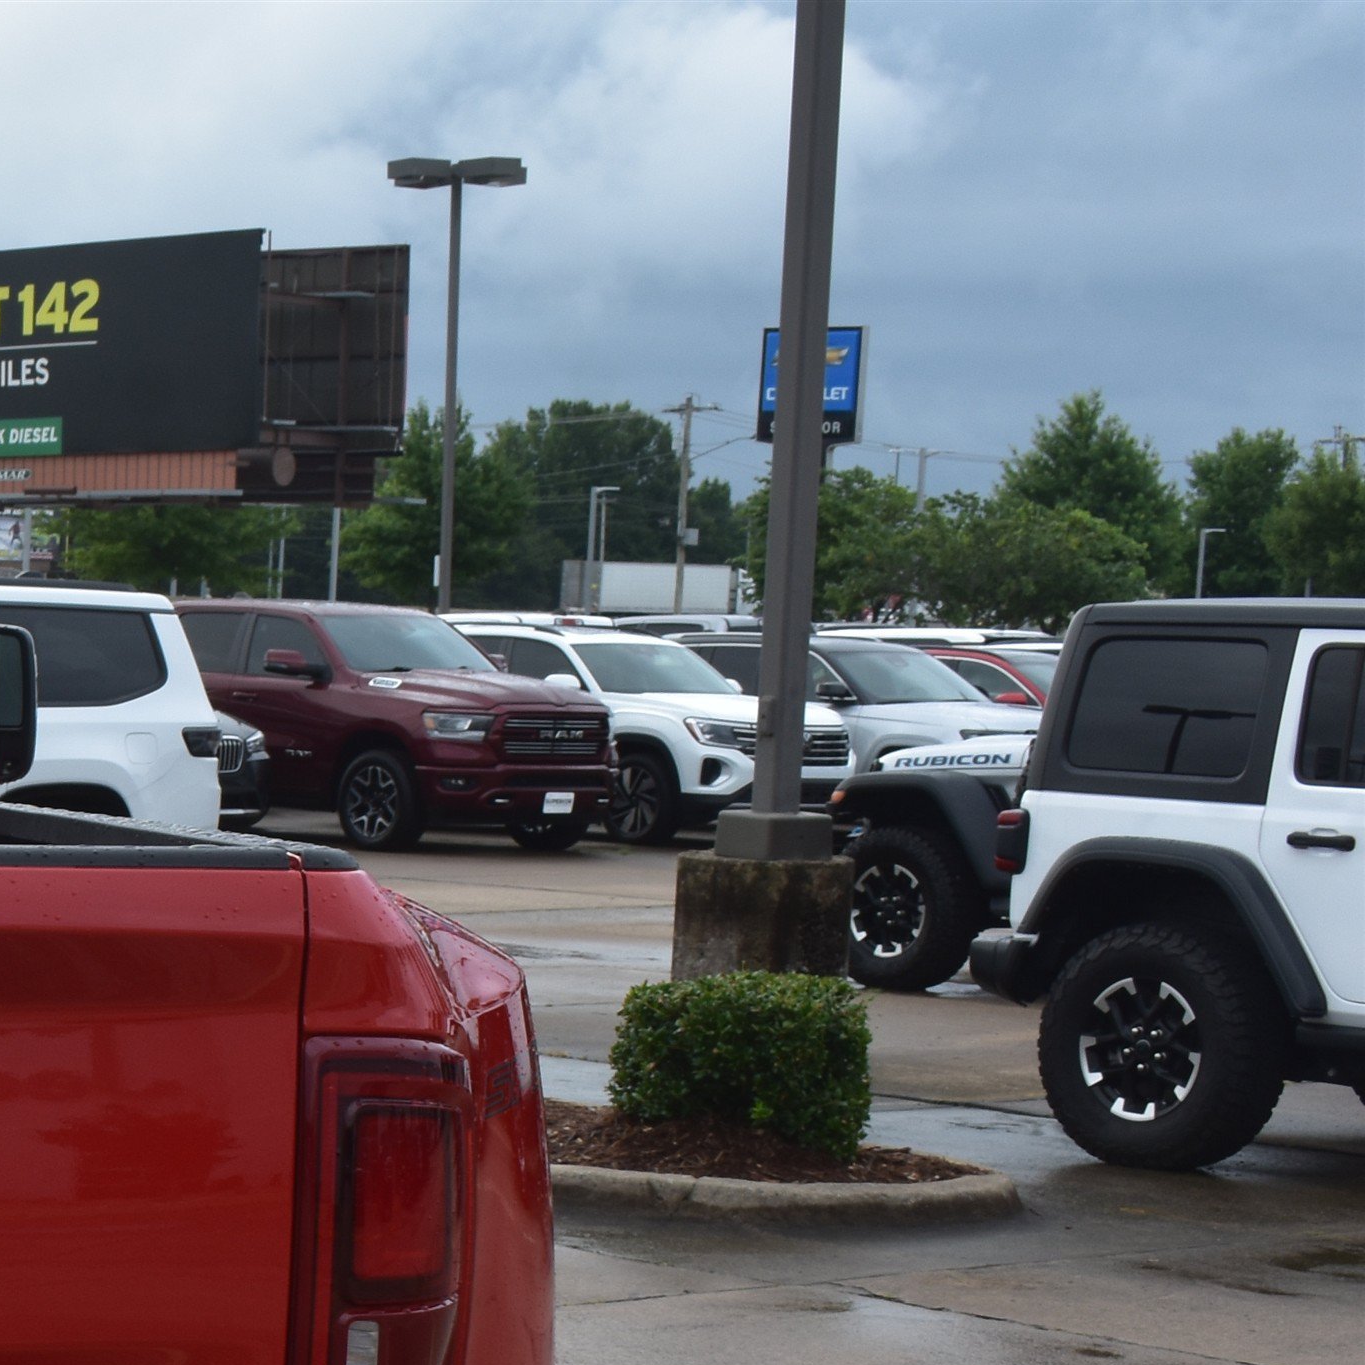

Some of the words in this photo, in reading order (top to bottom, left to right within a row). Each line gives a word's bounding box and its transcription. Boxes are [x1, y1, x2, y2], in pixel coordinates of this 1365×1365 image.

[17, 278, 100, 336] 142
[9, 426, 58, 443] DIESEL
[894, 754, 1012, 768] RUBICON
